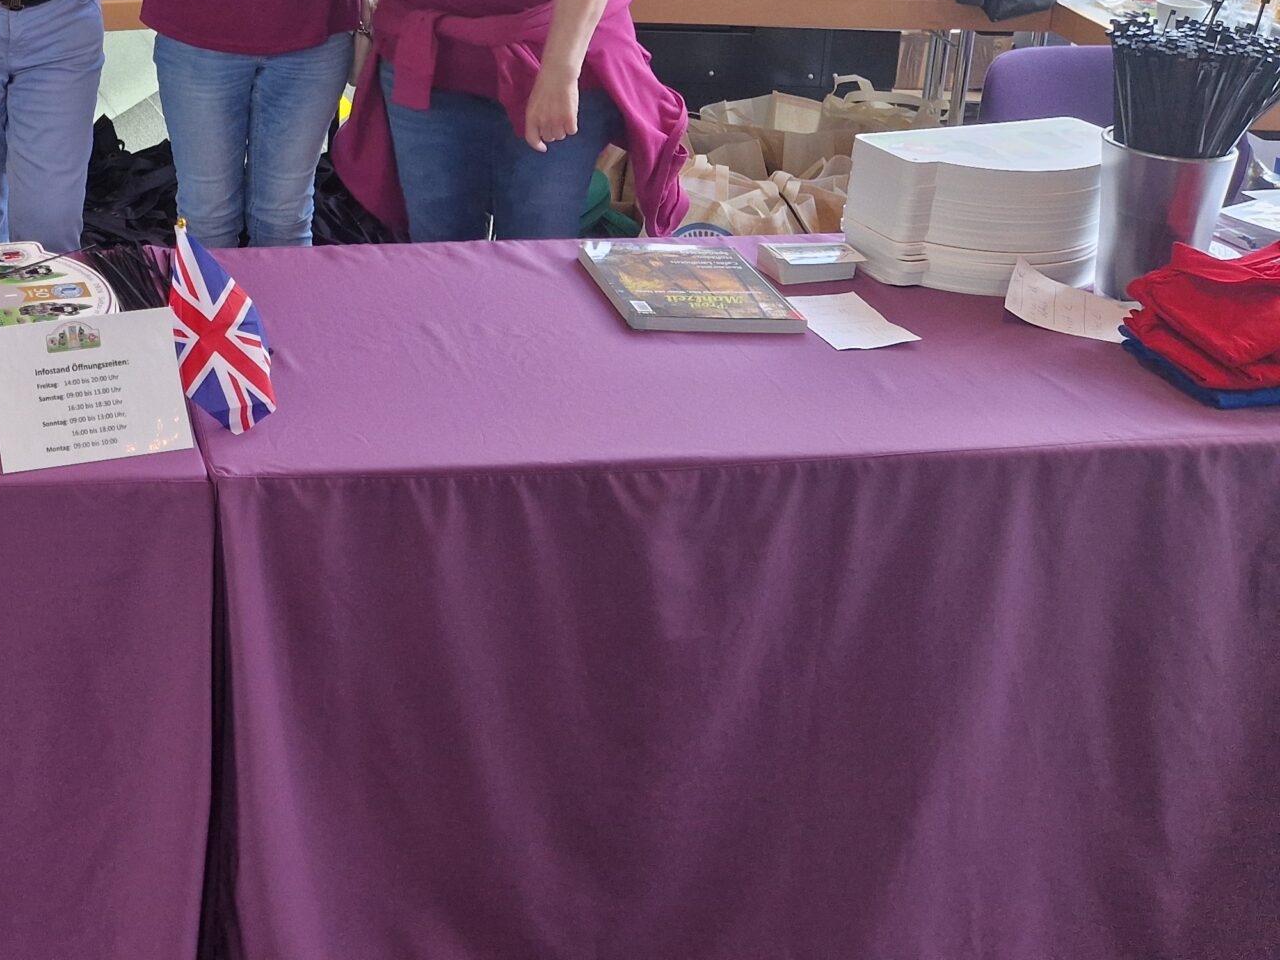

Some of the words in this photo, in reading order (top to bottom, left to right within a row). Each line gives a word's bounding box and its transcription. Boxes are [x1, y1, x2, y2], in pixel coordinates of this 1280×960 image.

[33, 288, 50, 297] 50
[35, 365, 70, 376] Infostand
[72, 359, 130, 372] Öffnungszeiten:
[64, 378, 80, 386] 14:00
[91, 375, 107, 383] 20:00
[66, 391, 83, 399] 09:00
[68, 404, 84, 412] 16:30
[72, 429, 88, 437] 16:00
[99, 425, 115, 433] 18:00
[73, 441, 90, 449] 09:00
[101, 438, 118, 446] 10:00
